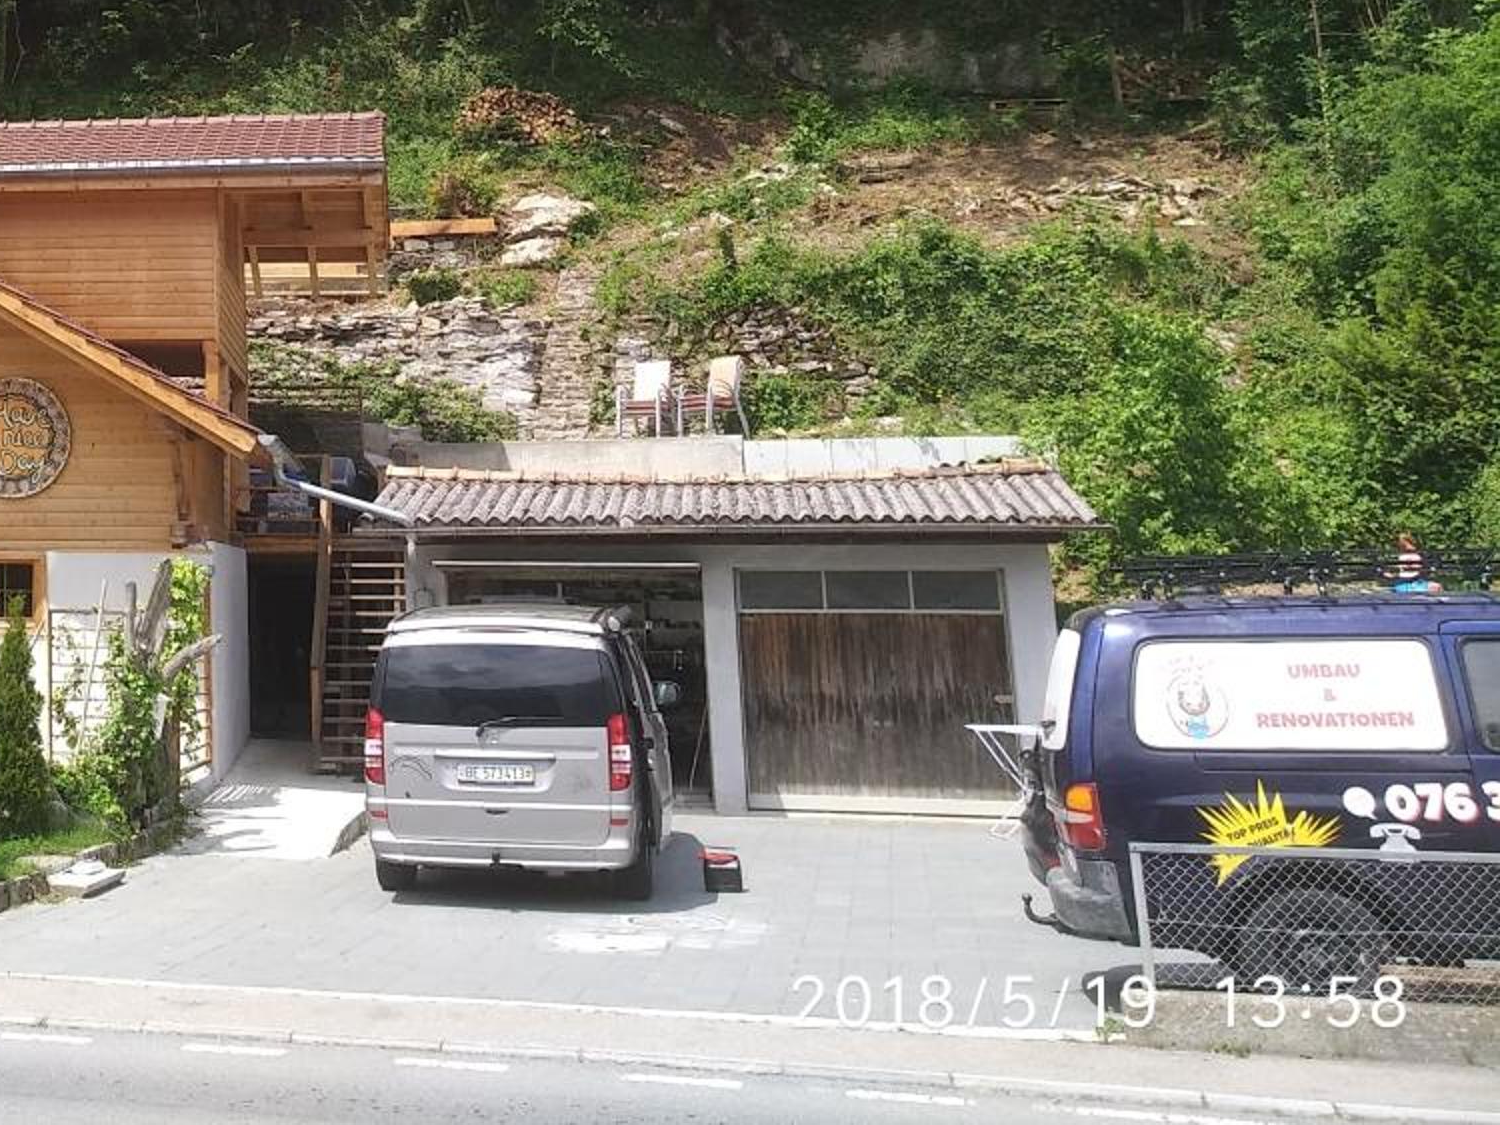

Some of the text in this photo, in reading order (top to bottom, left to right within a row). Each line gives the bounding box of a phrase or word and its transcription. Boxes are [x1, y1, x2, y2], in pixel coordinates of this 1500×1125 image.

[1287, 663, 1361, 679] UMBAU
[1323, 687, 1337, 702] &
[1384, 781, 1479, 824] 076
[1226, 817, 1280, 842] TOP PREIS
